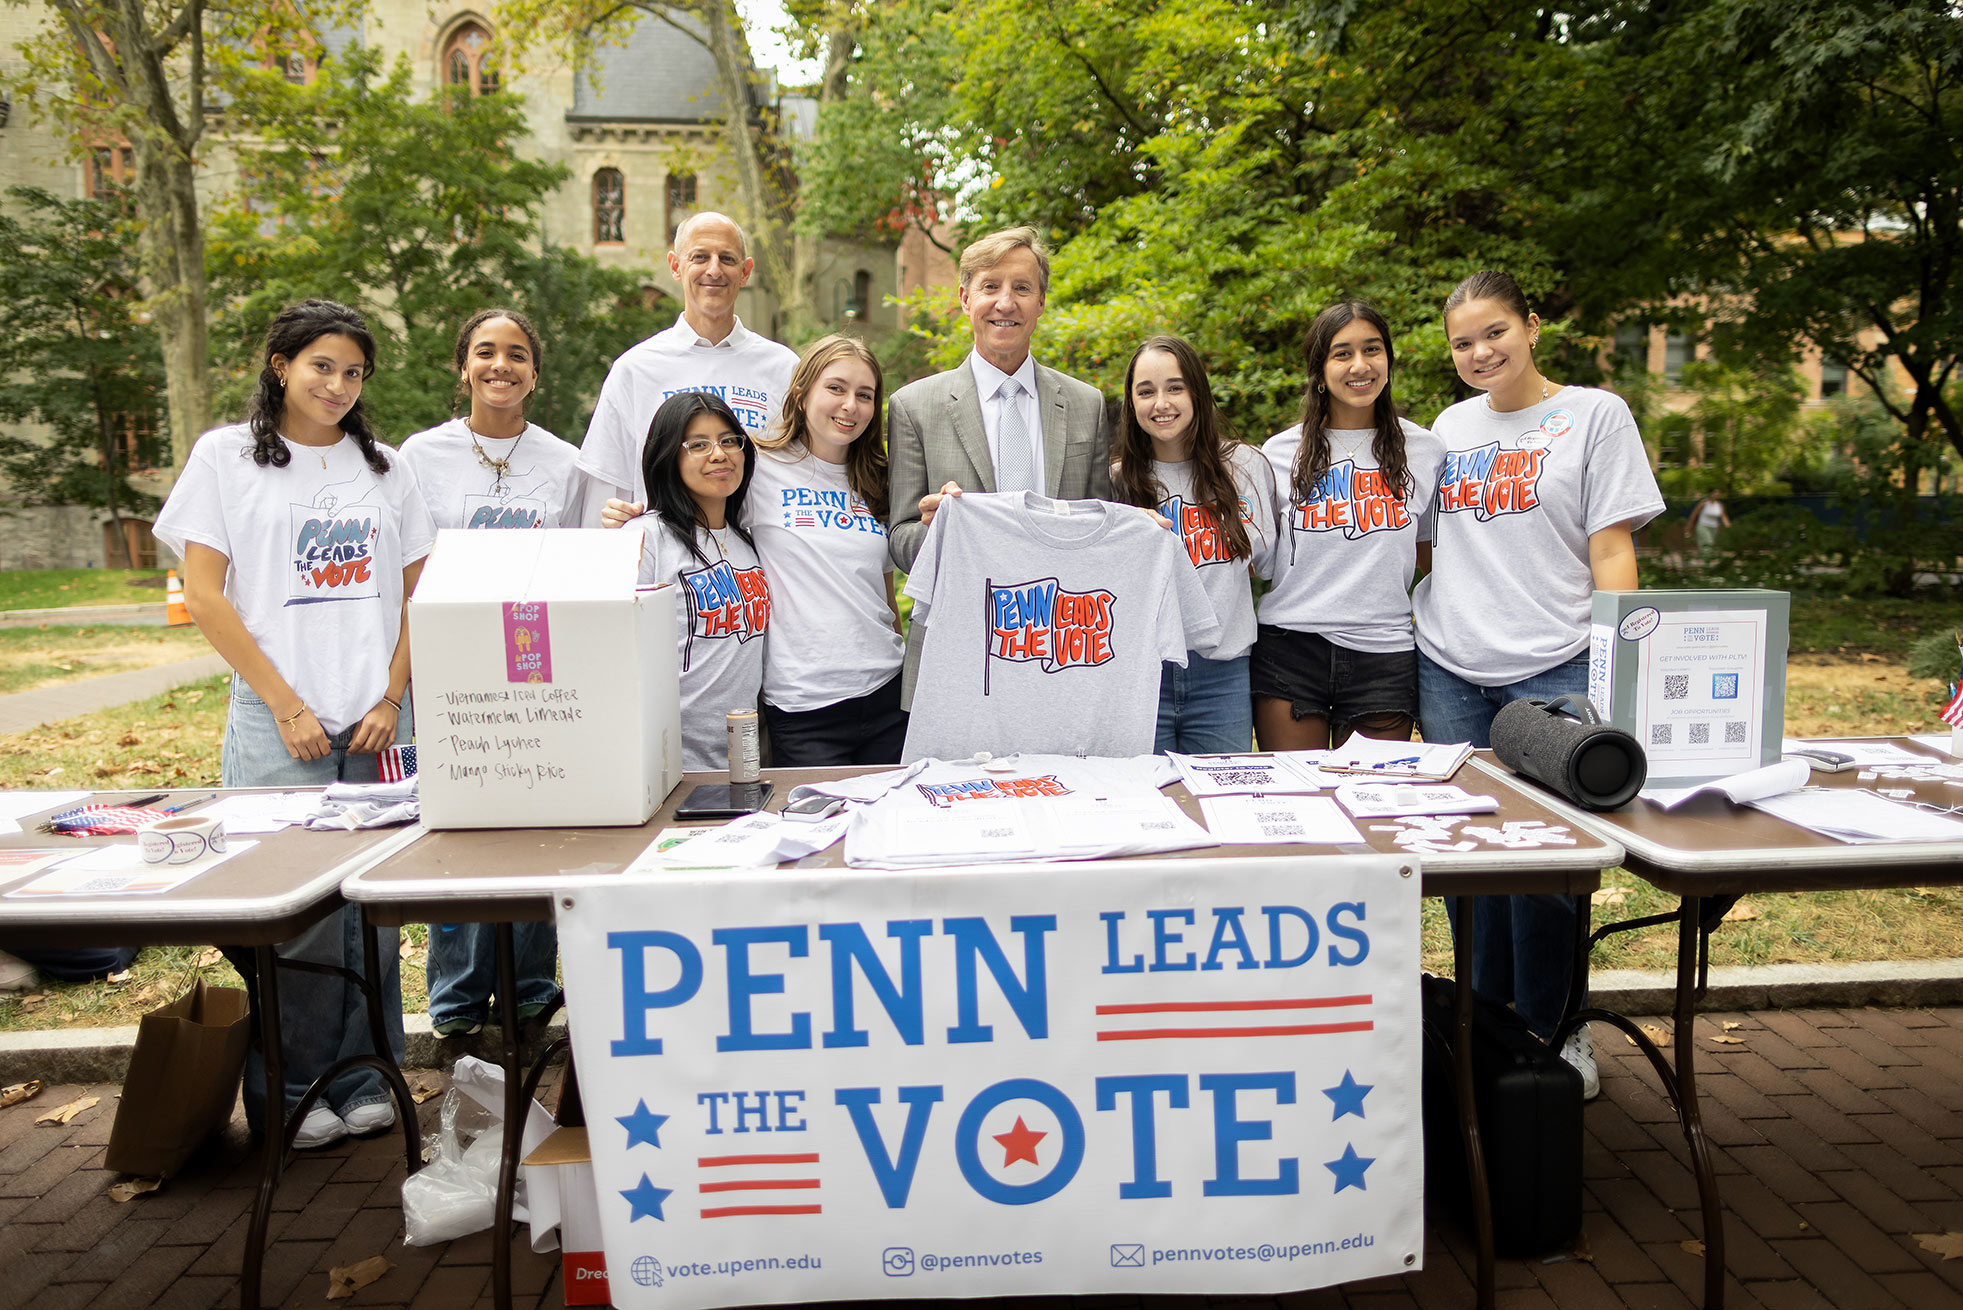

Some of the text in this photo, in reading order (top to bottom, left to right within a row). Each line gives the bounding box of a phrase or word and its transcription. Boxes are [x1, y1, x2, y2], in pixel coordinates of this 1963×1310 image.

[732, 385, 768, 402] LEADS
[1489, 449, 1545, 483] LEADS
[781, 487, 847, 510] PENN
[1440, 476, 1537, 516] THE VOTE
[467, 505, 537, 529] PENN
[816, 511, 883, 536] VOTE
[1297, 497, 1408, 533] THE VOTE
[297, 517, 371, 556] PENN
[306, 544, 368, 562] LEADS
[294, 556, 372, 589] THE VOTE
[688, 564, 741, 610] PENN
[513, 612, 539, 621] SHOP
[698, 600, 742, 636] THE
[993, 583, 1111, 631] PENN LEADS
[994, 622, 1112, 667] THE VOTE
[1598, 636, 1608, 682] PENN
[516, 661, 542, 670] SHOP
[1590, 658, 1599, 702] VOTE
[541, 688, 579, 704] Coffee
[447, 706, 583, 726] Watermelon Limeade
[450, 734, 542, 759] Peach Lychee
[450, 762, 566, 790] Mango Sticky Rice
[606, 900, 1372, 1057] PENN LEADS
[697, 1070, 1301, 1209] THE VOTE
[667, 1232, 1375, 1277] vote.upenn.edu @pennvotes pennvotes@upenn.edu
